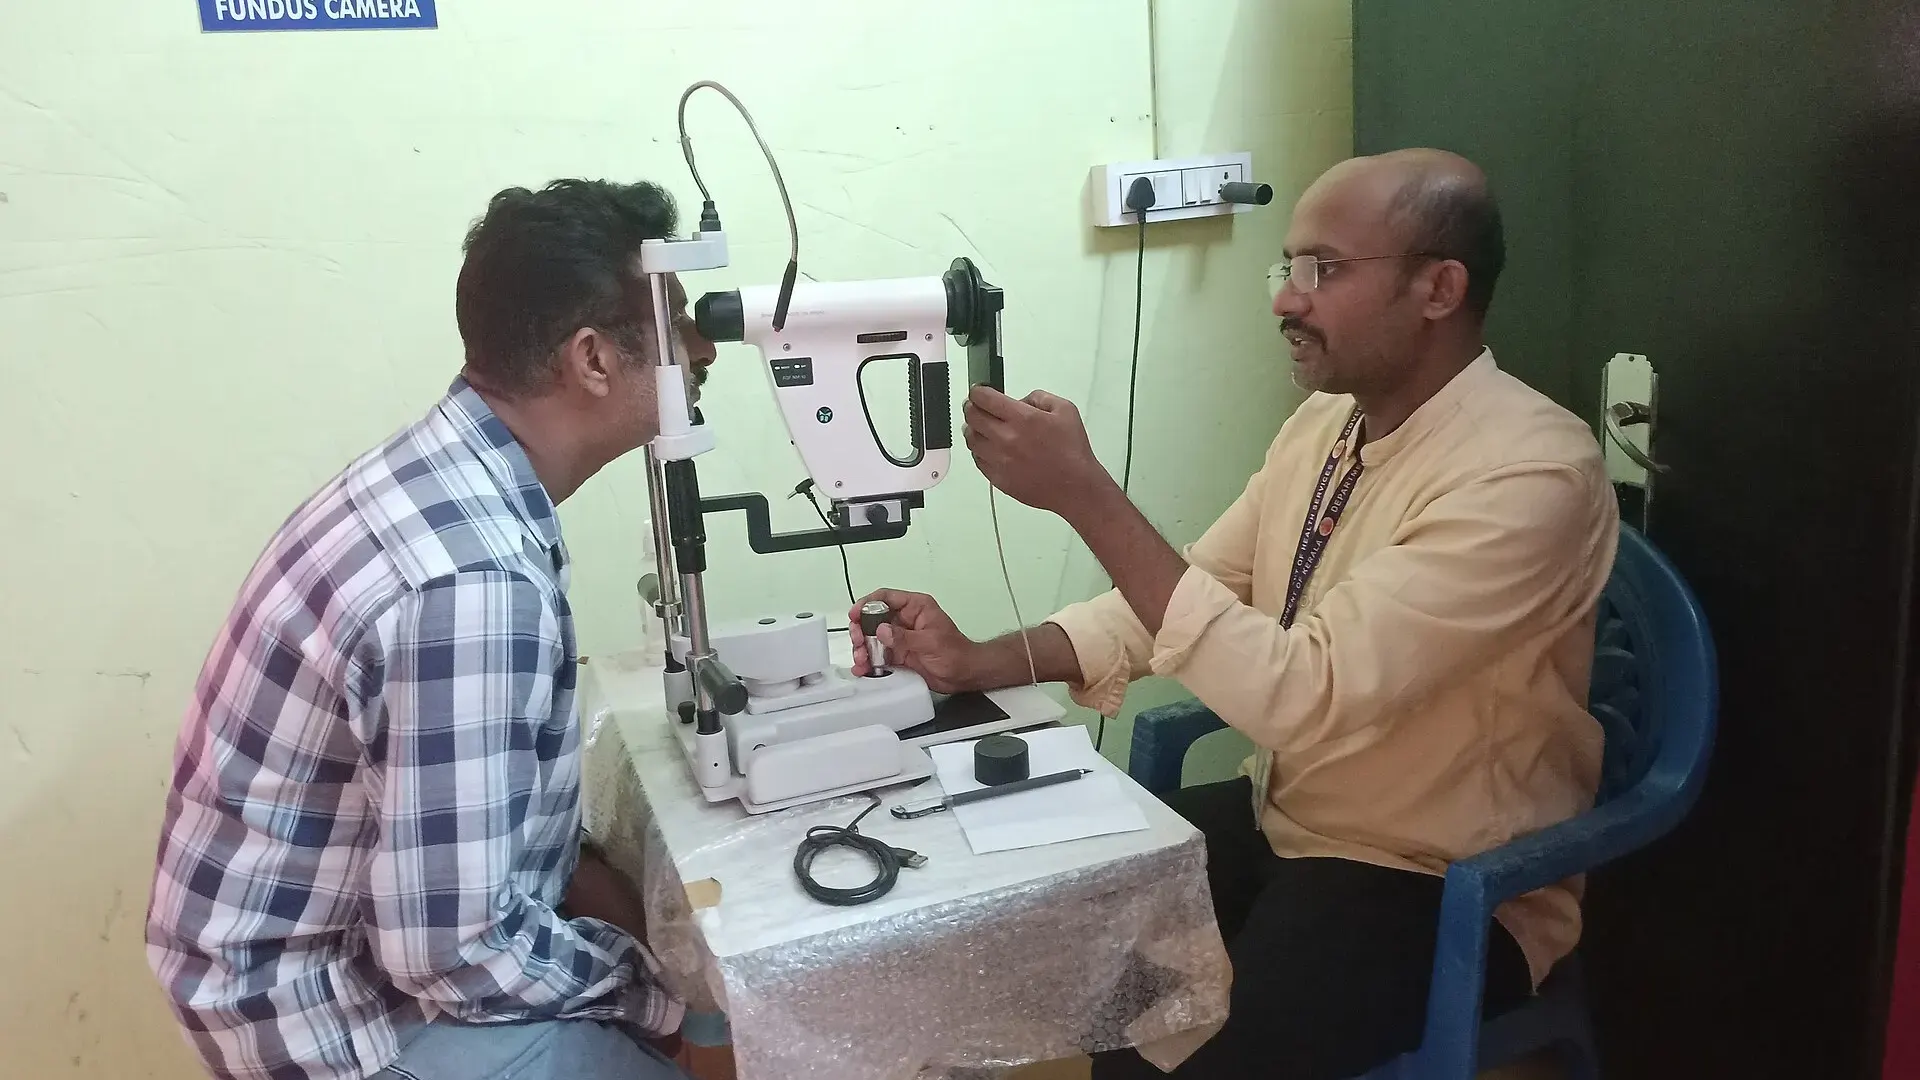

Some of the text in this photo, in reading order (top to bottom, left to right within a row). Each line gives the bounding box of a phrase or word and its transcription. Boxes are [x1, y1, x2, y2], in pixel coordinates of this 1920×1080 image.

[215, 0, 421, 20] FUNDUS CAMERA
[1297, 553, 1304, 566] OF
[1301, 513, 1315, 551] HEALTH
[1313, 464, 1333, 511] SERVICES
[1296, 576, 1303, 589] OF
[1302, 540, 1323, 575] KERALA
